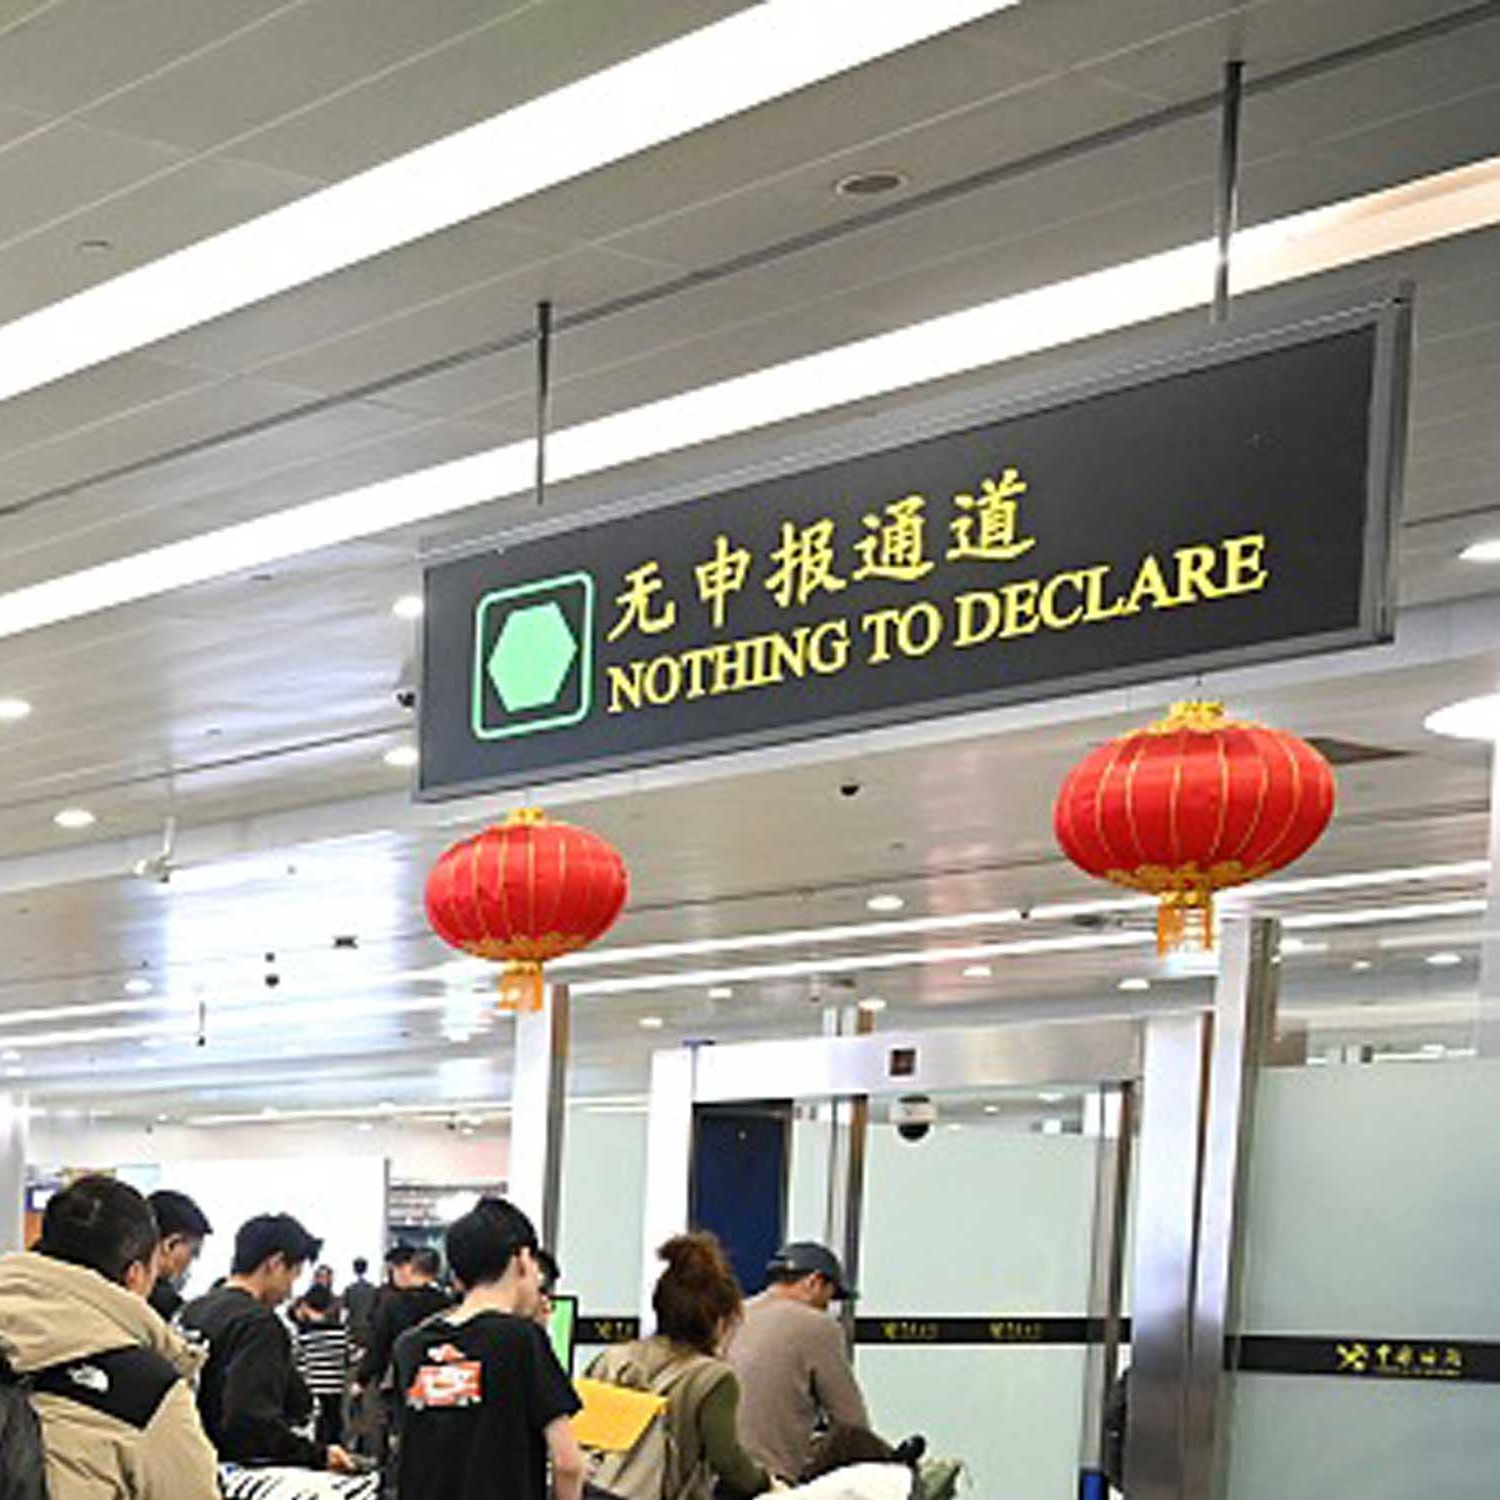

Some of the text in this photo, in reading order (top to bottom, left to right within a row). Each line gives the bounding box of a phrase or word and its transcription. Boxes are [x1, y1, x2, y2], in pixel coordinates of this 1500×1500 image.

[606, 534, 1269, 713] NOTHING TO DECLARE
[607, 467, 1036, 642] 无申报通道
